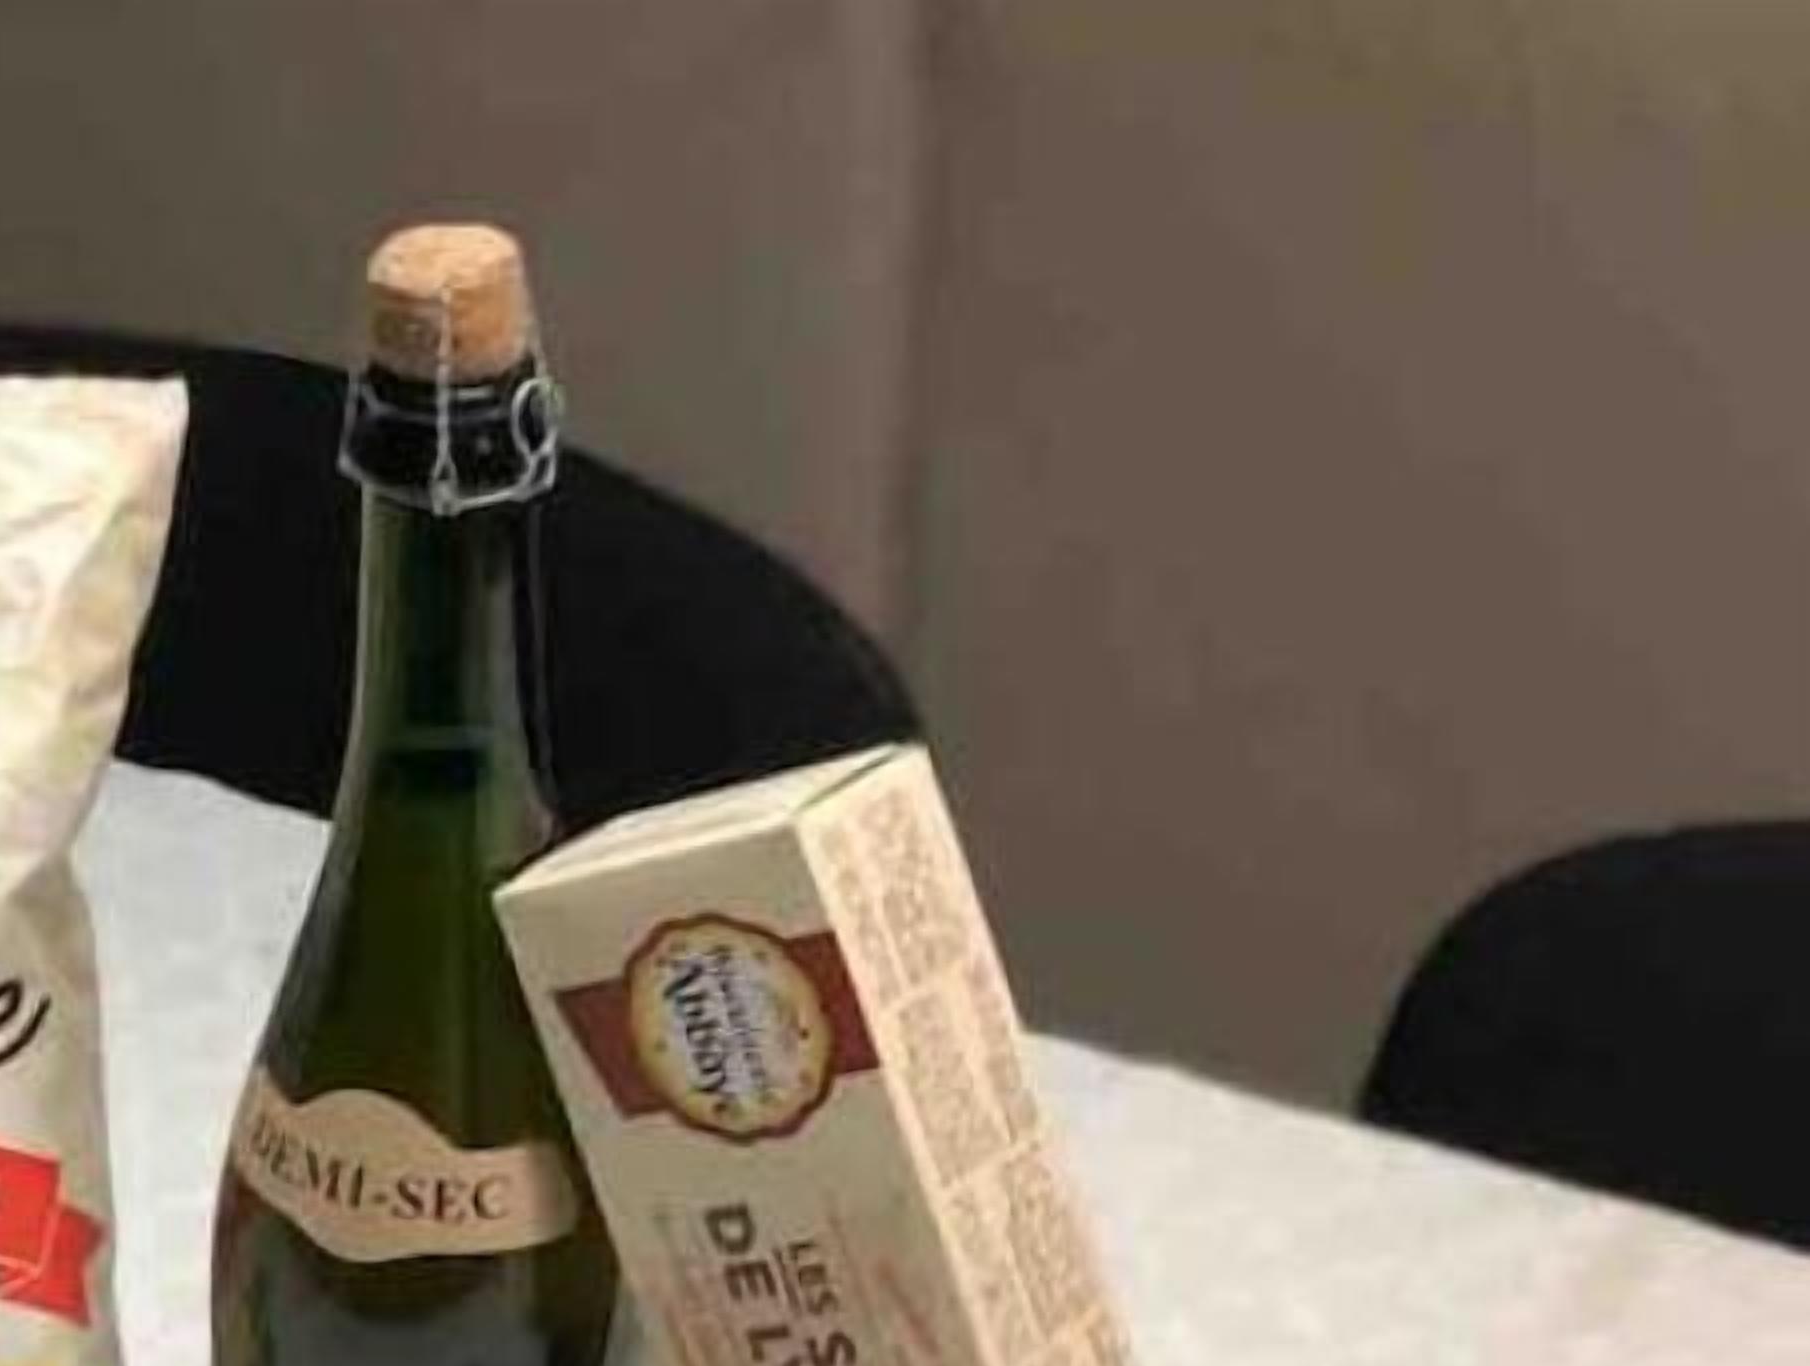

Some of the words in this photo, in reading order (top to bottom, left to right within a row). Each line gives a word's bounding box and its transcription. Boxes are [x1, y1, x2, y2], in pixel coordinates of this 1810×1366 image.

[250, 1112, 511, 1224] DEMI-SEC
[704, 1202, 778, 1301] DE
[790, 1238, 841, 1316] LES
